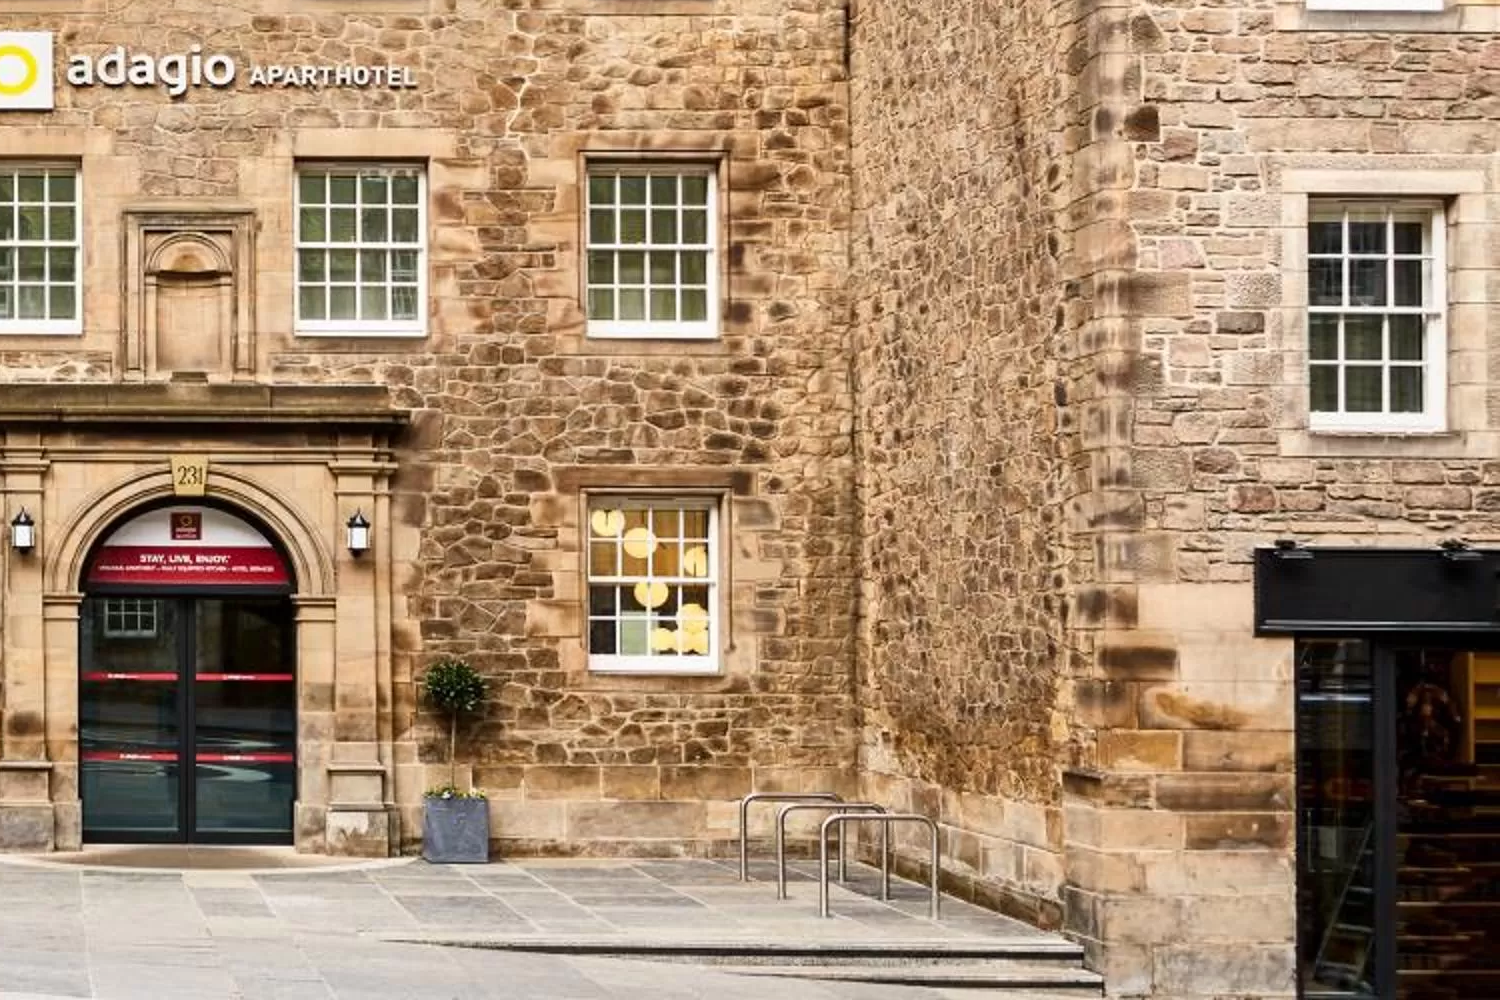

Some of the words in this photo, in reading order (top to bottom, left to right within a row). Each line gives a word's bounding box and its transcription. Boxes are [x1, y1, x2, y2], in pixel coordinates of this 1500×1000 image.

[67, 45, 235, 96] adagio
[250, 65, 418, 88] APARTHOTEL
[177, 466, 203, 486] 231
[140, 554, 167, 565] STAY,
